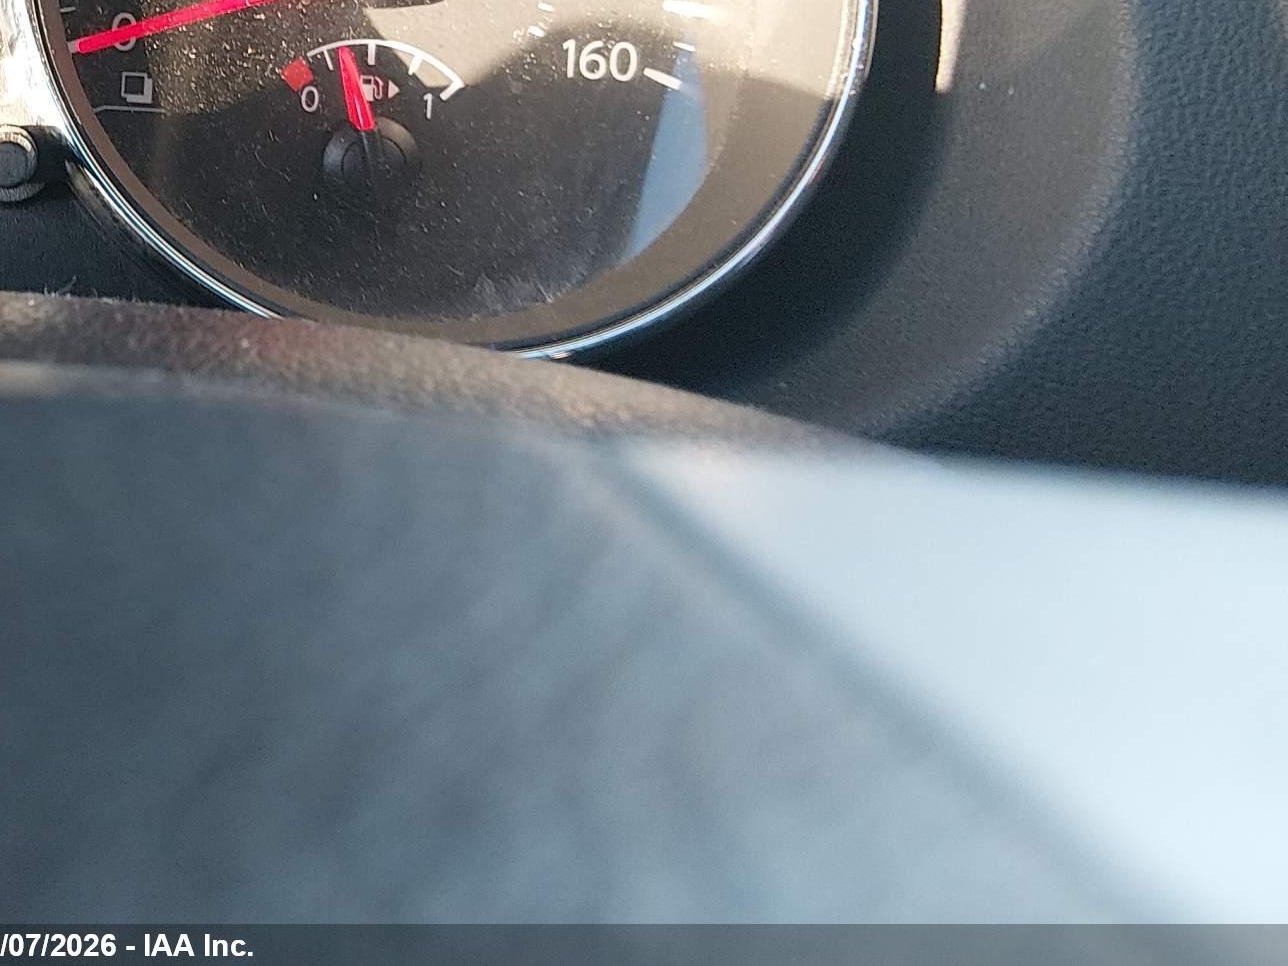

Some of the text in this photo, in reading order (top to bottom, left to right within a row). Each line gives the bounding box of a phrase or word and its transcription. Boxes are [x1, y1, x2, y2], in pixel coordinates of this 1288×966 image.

[562, 38, 638, 82] 160
[300, 85, 319, 113] 0
[423, 93, 433, 120] 1
